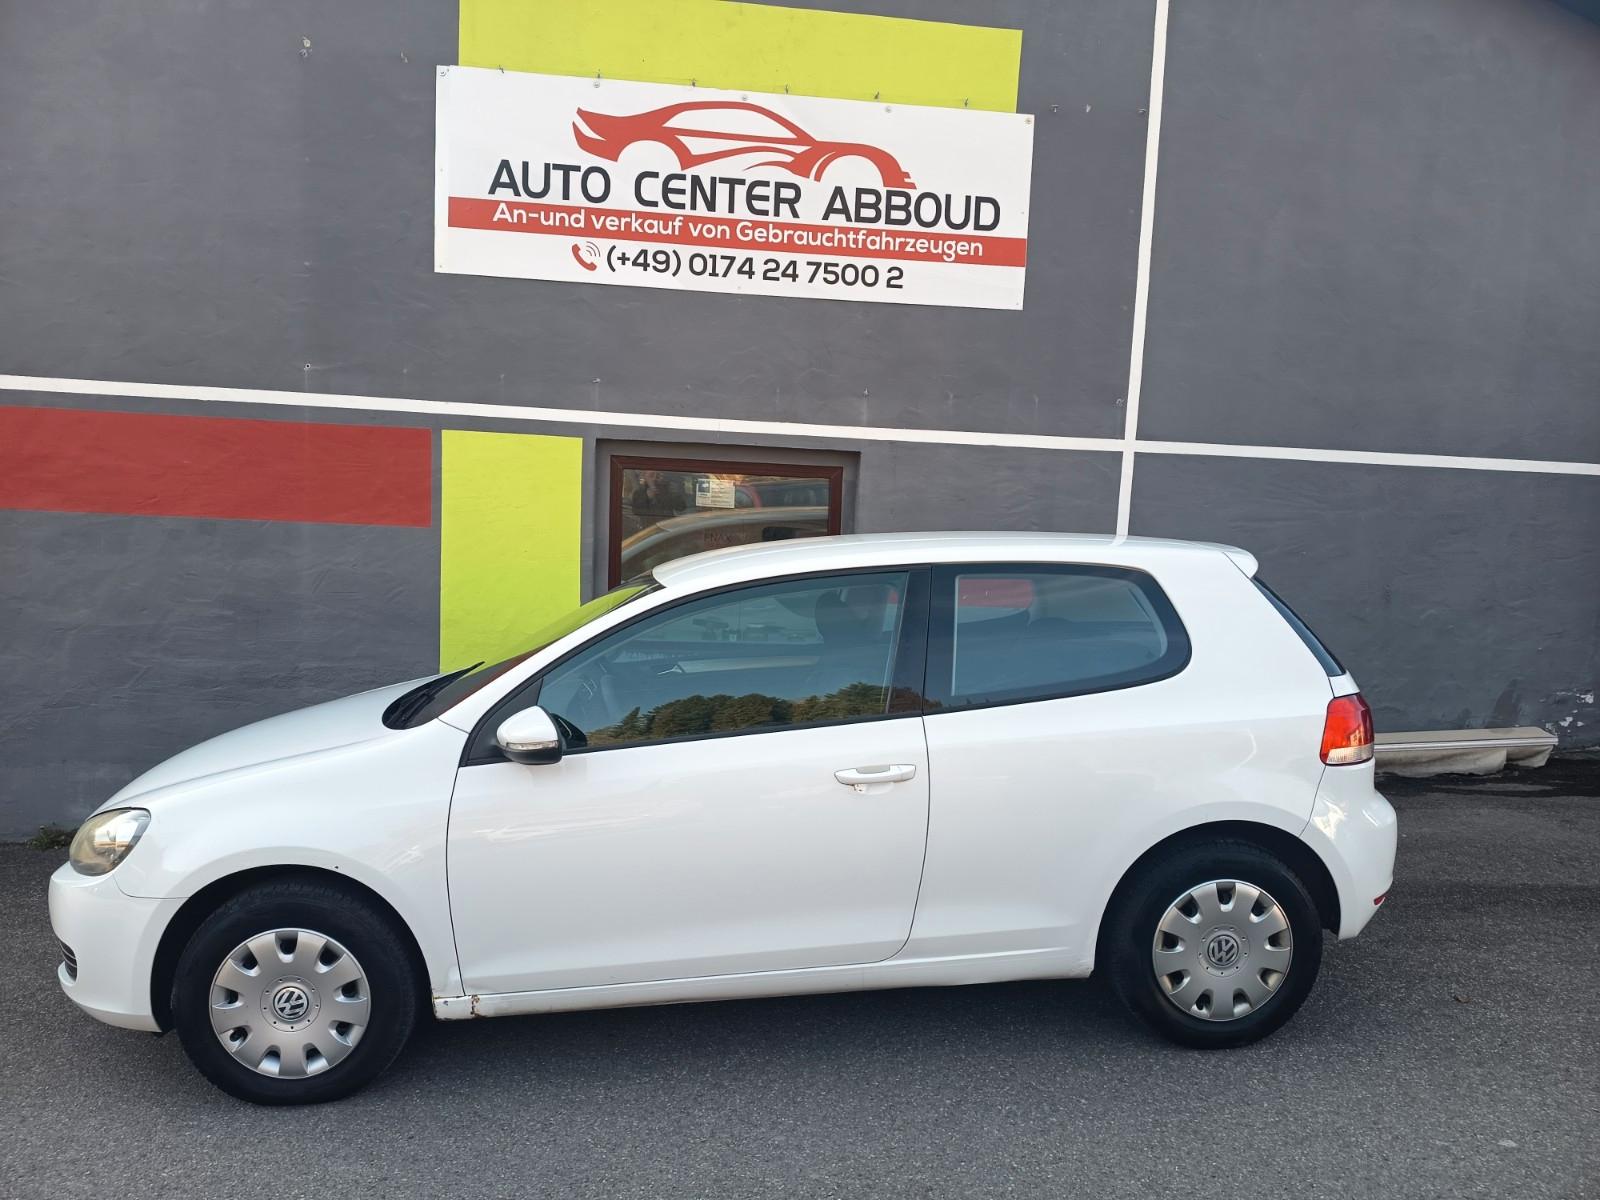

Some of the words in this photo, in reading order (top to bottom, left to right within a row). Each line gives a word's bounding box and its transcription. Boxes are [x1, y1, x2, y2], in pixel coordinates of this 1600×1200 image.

[488, 159, 611, 203] AUTO
[634, 170, 802, 219] CENTER
[822, 185, 1001, 231] ABBOUD
[492, 202, 585, 229] An-und
[591, 212, 684, 236] verkauf
[688, 222, 731, 240] von
[736, 221, 983, 262] Gebrauchtfahrzeugen
[606, 245, 682, 277] (+49)
[688, 252, 756, 280] 0174
[762, 258, 799, 283] 24
[806, 261, 880, 288] 7500
[886, 266, 904, 289] 2
[1207, 935, 1239, 966] VW
[273, 986, 309, 1020] VW
